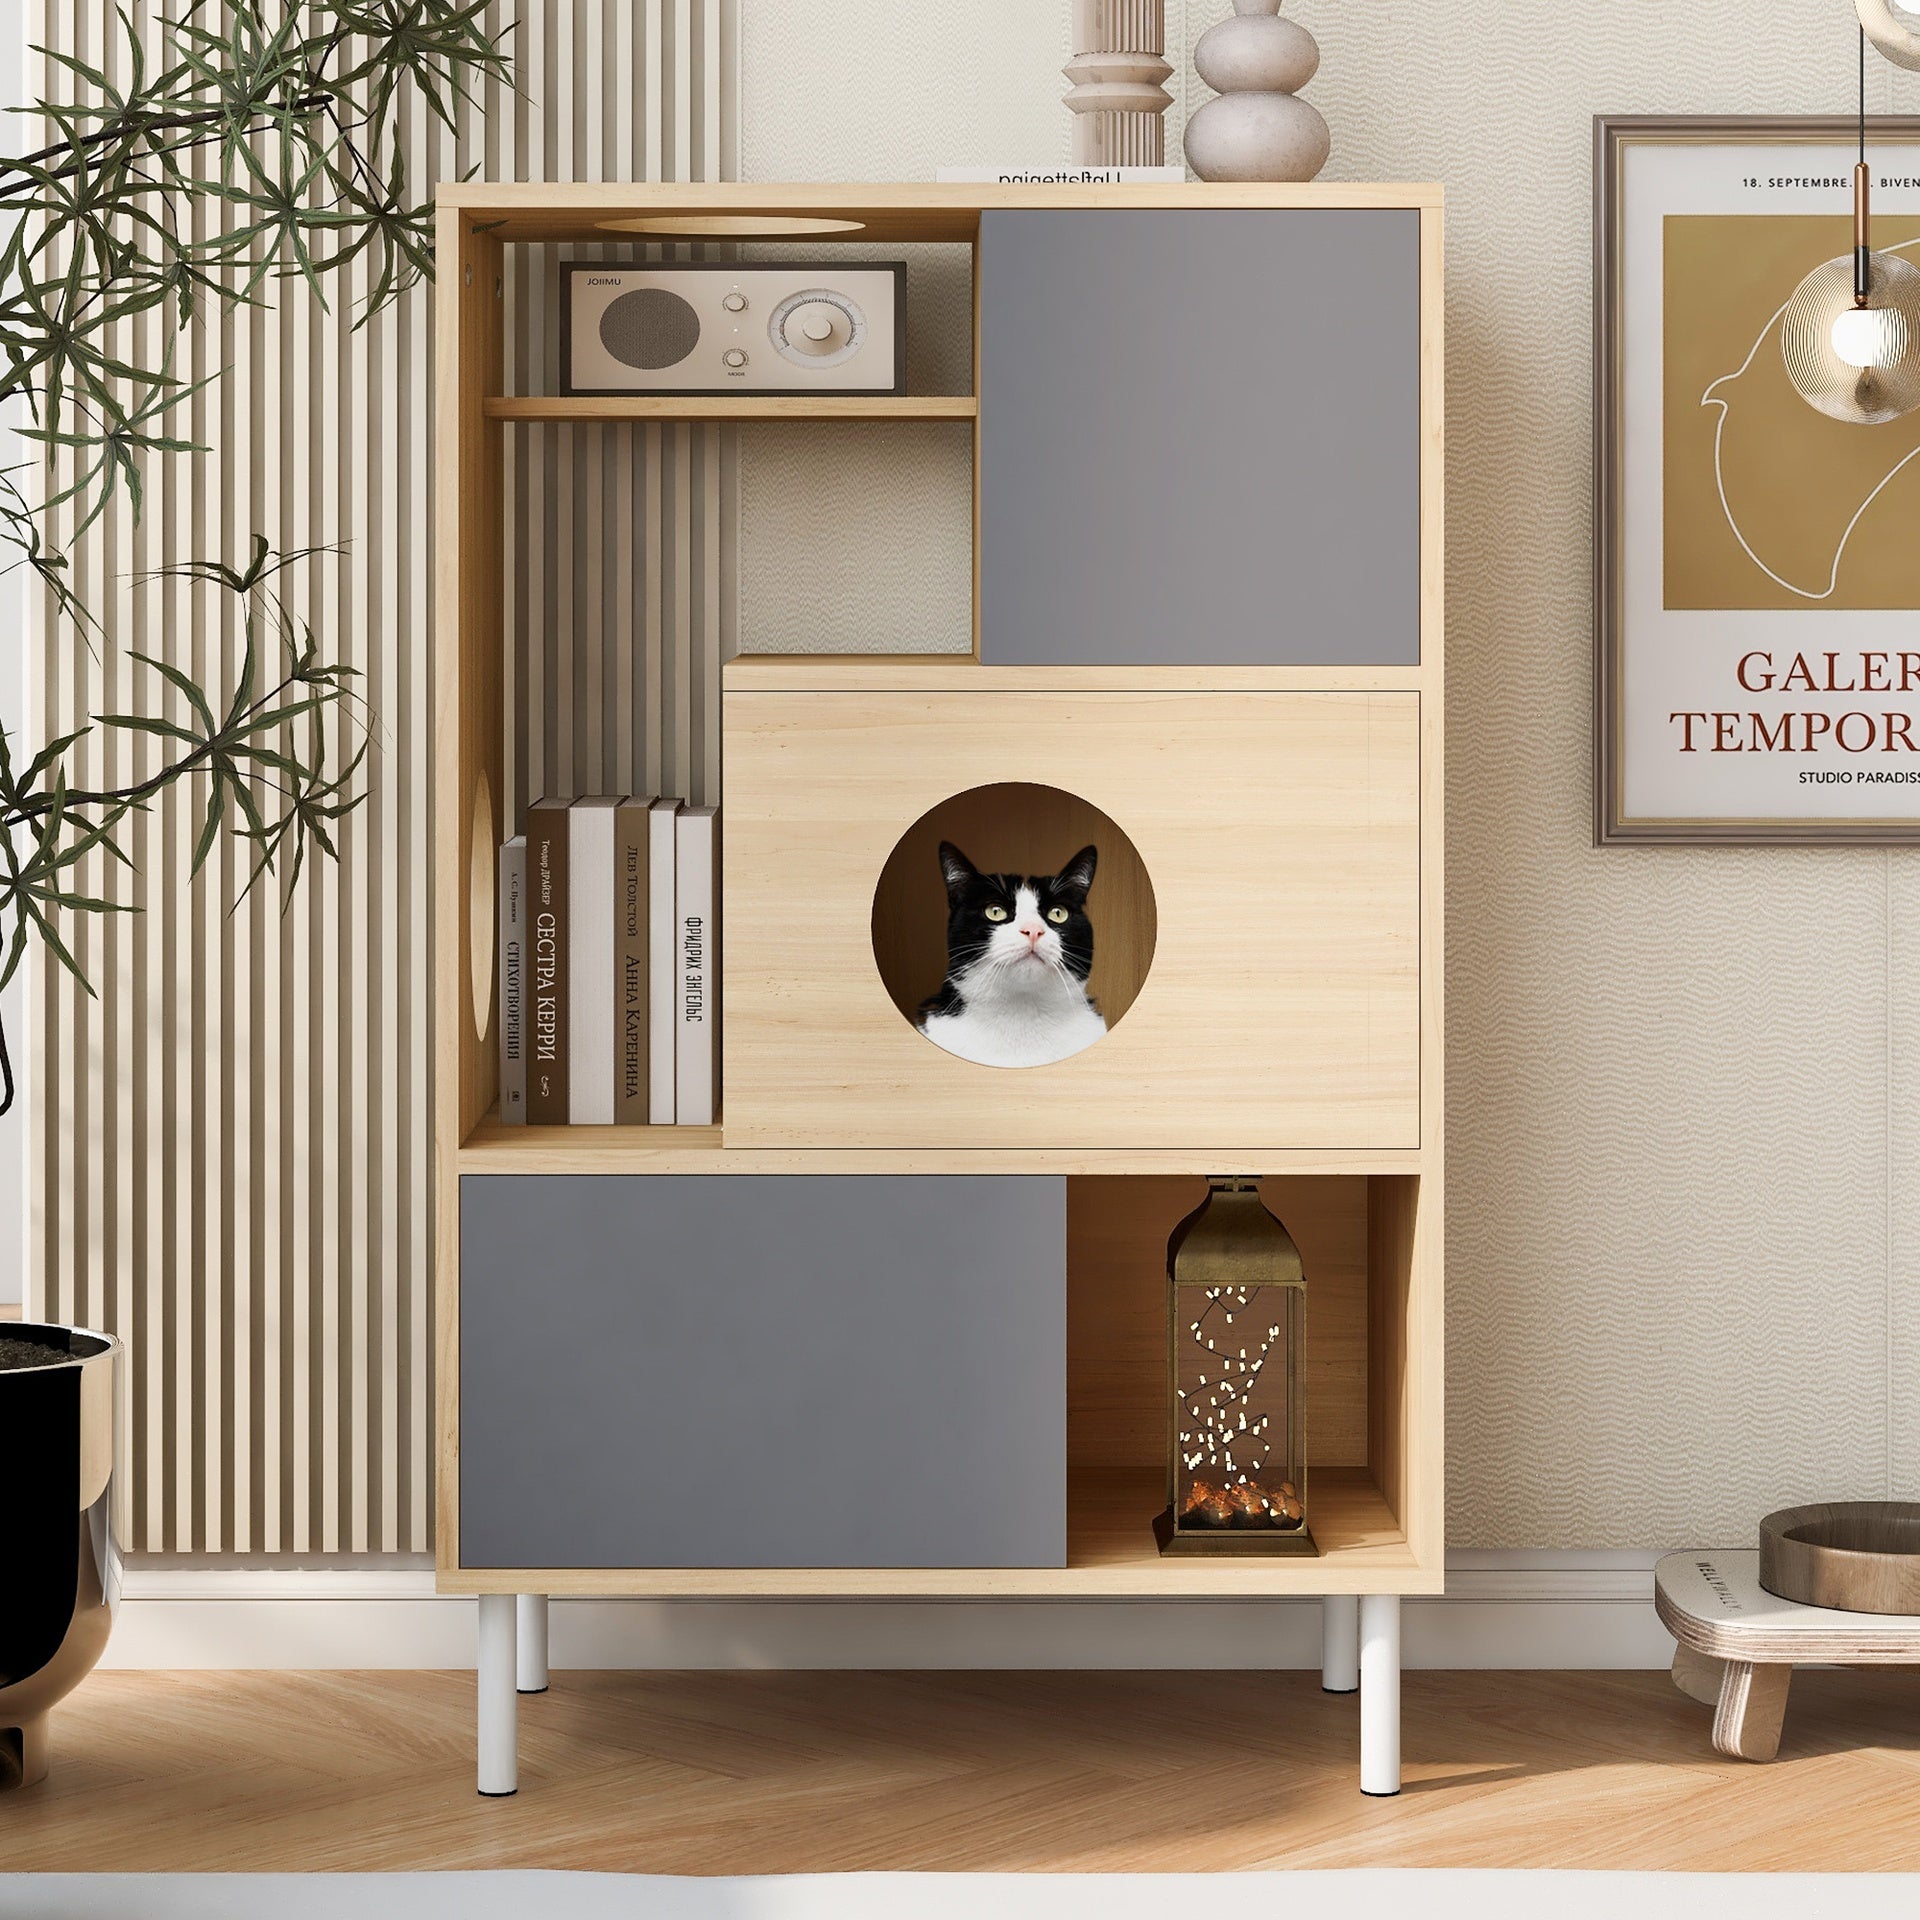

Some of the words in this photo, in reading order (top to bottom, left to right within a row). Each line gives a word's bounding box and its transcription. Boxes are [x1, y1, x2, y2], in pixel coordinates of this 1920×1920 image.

[1743, 177, 1762, 188] 18.
[1736, 651, 1920, 693] GALER
[1668, 711, 1920, 753] TEMPOR
[1799, 771, 1853, 784] STUDIO
[537, 912, 556, 991] СЕСТРА
[684, 916, 704, 970] ФРИДРИХ
[507, 941, 520, 1060] СТИХОТВОРЕНИЯ
[685, 974, 703, 1022] ЭНГЕЛЬС
[537, 996, 556, 1061] КЕРРИ
